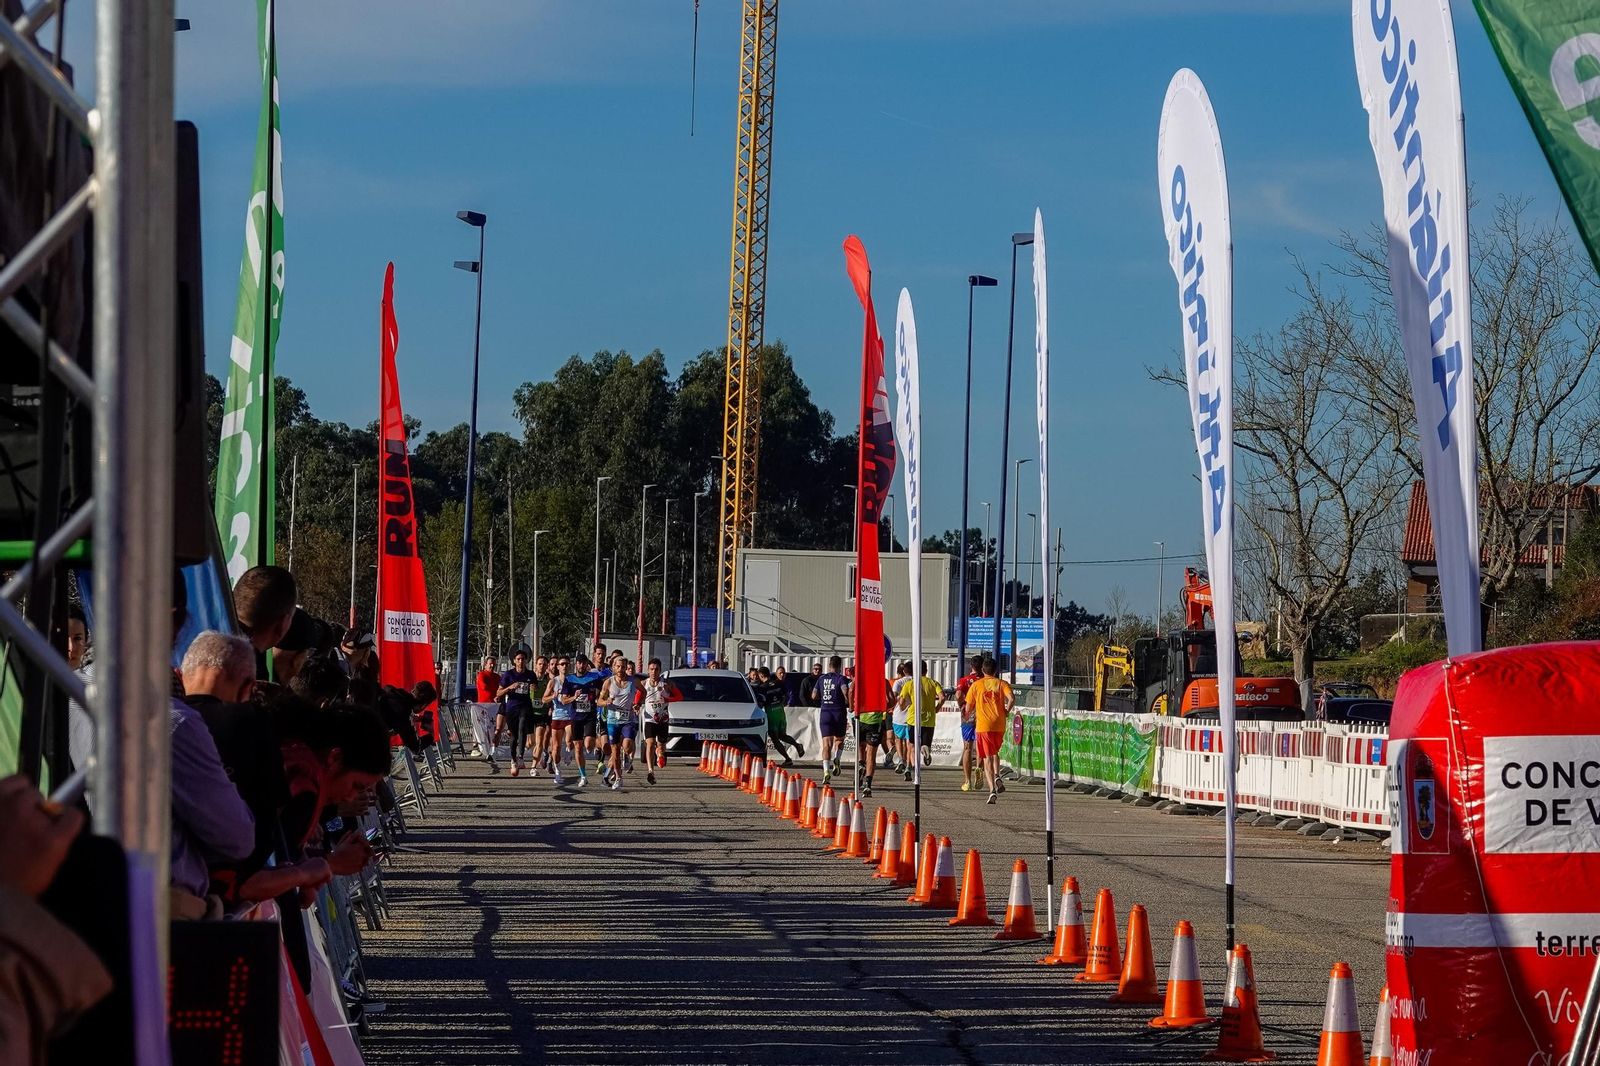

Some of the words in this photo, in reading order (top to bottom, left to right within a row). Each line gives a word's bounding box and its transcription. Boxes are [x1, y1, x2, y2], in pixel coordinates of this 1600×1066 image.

[385, 439, 414, 558] RUN
[861, 584, 881, 596] ONCEL
[387, 617, 425, 628] CONCELLO
[390, 627, 400, 635] DE
[402, 627, 422, 637] VIGO
[1525, 799, 1572, 827] DE
